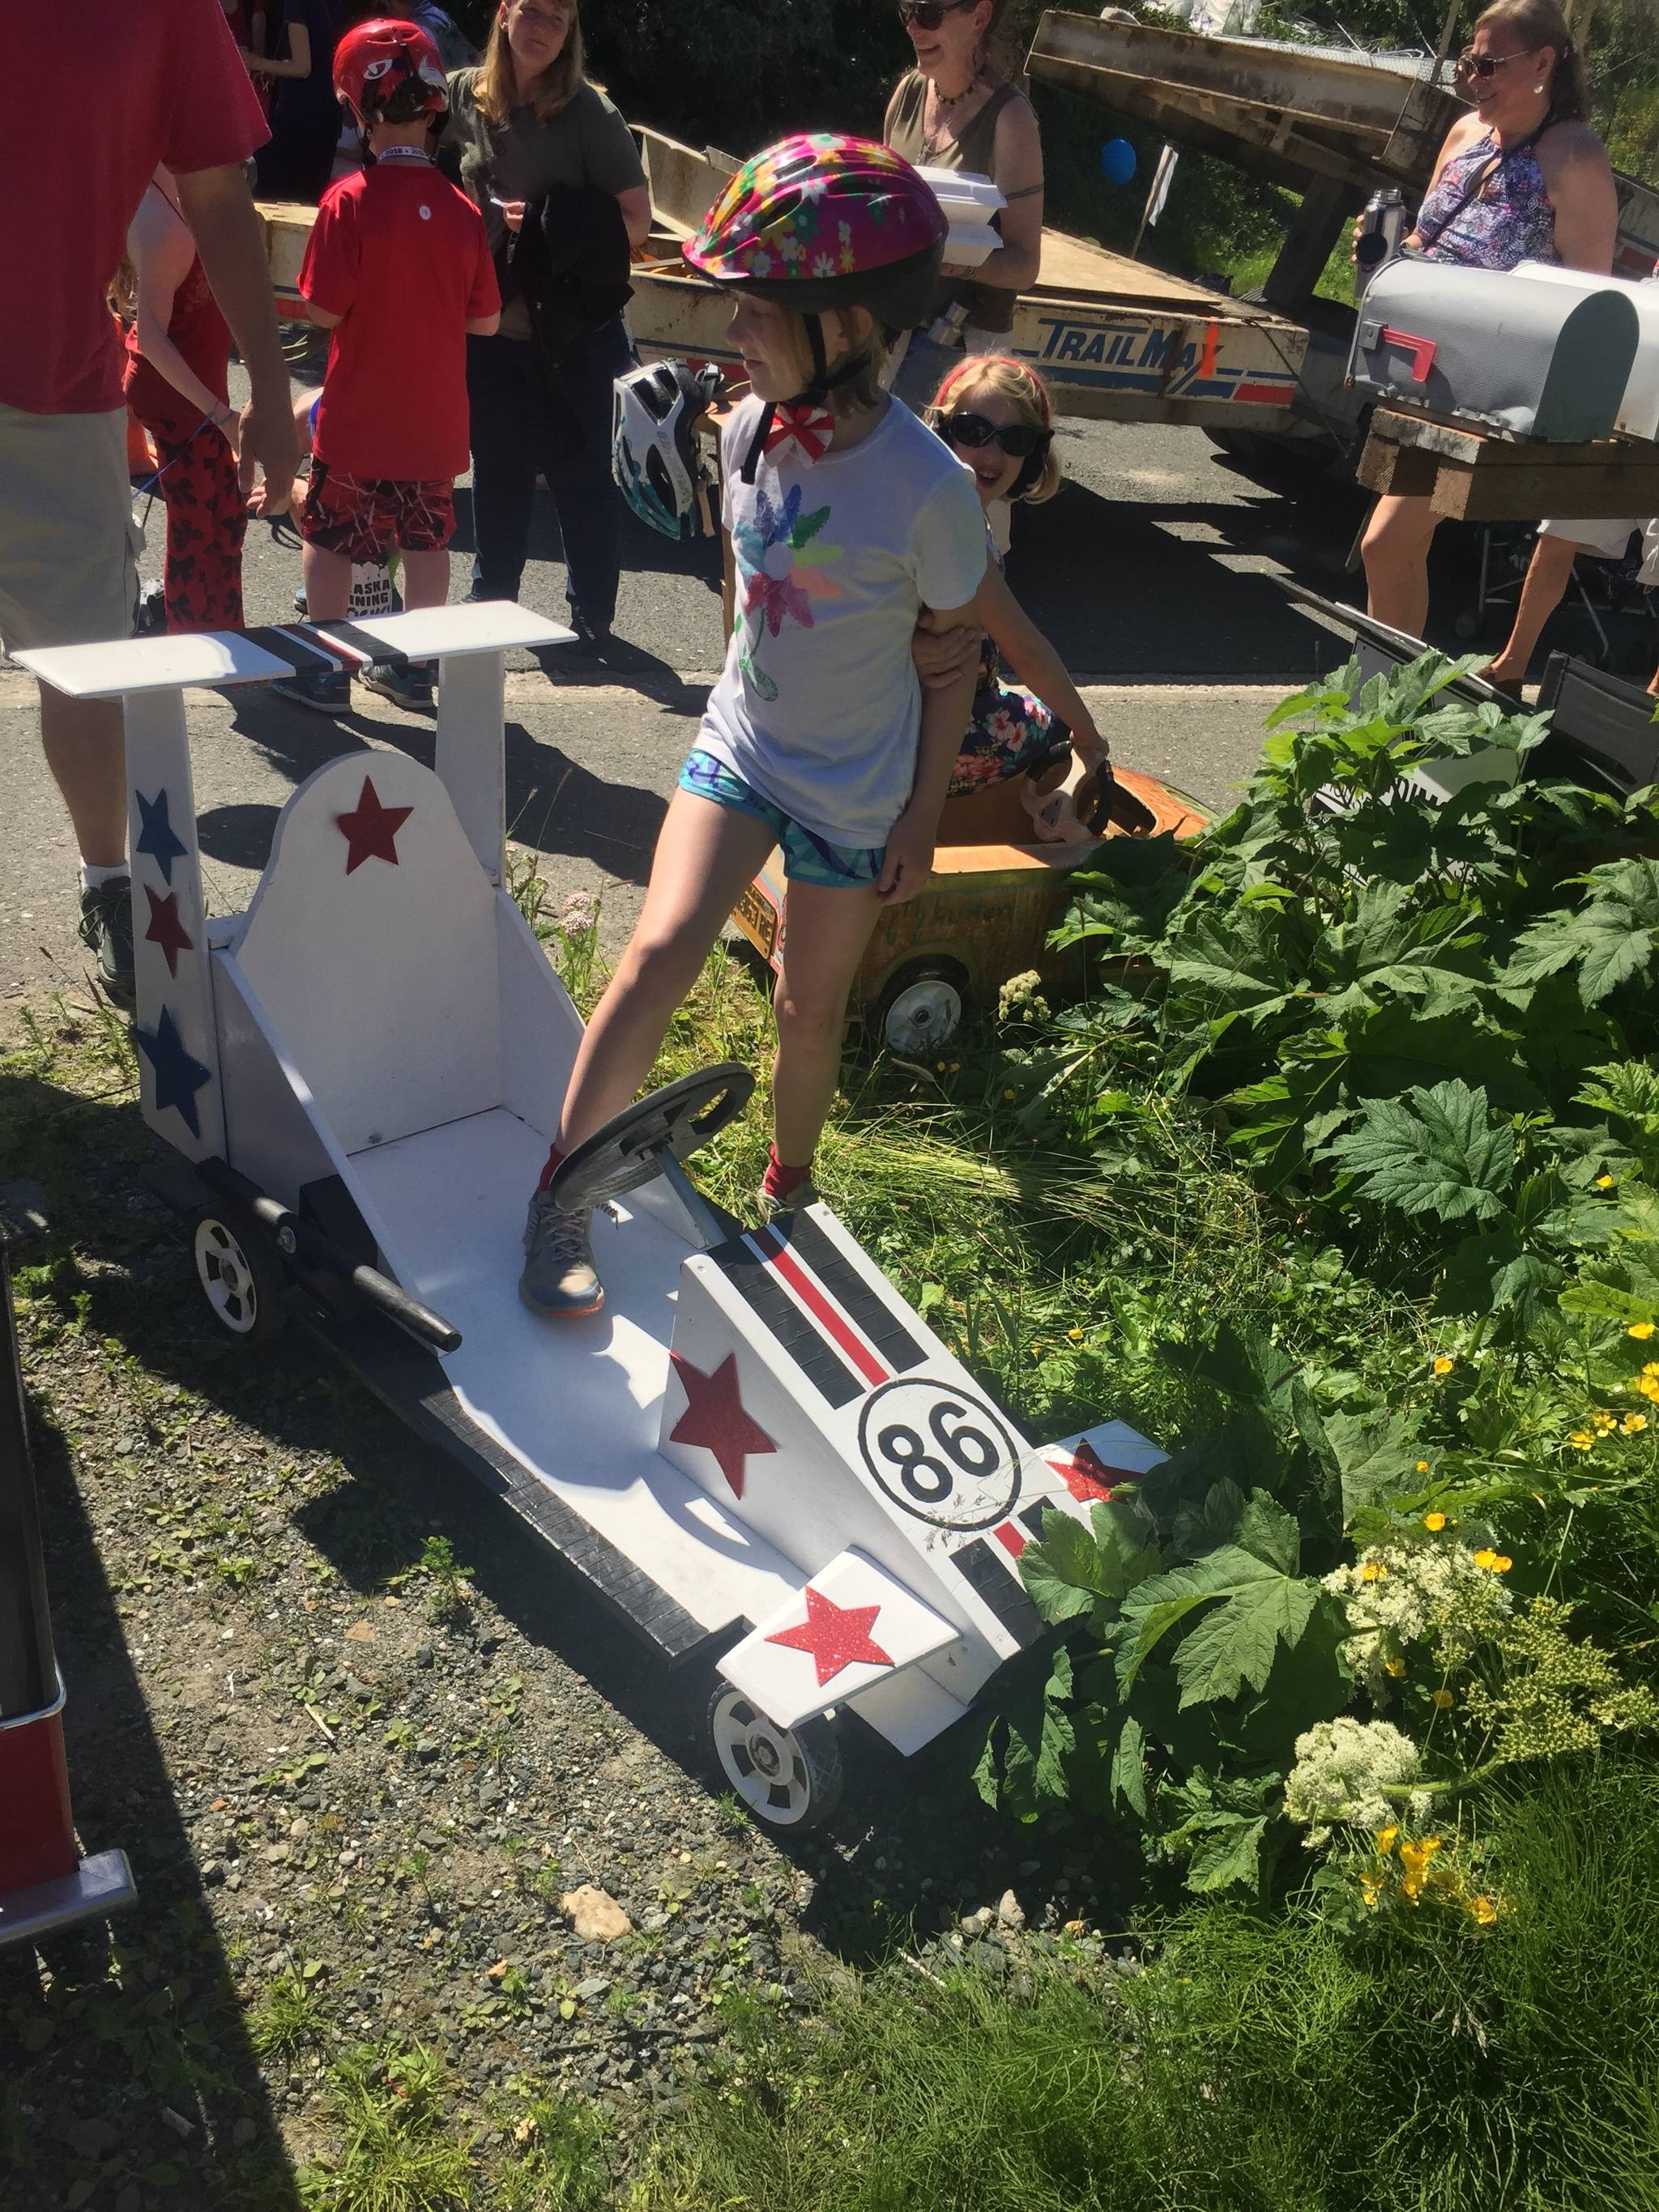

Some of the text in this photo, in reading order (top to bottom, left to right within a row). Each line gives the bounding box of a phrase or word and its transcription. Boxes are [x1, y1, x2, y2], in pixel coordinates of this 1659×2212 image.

[350, 579, 390, 595] ASKA
[349, 592, 389, 607] INING
[877, 1400, 1000, 1503] 86
